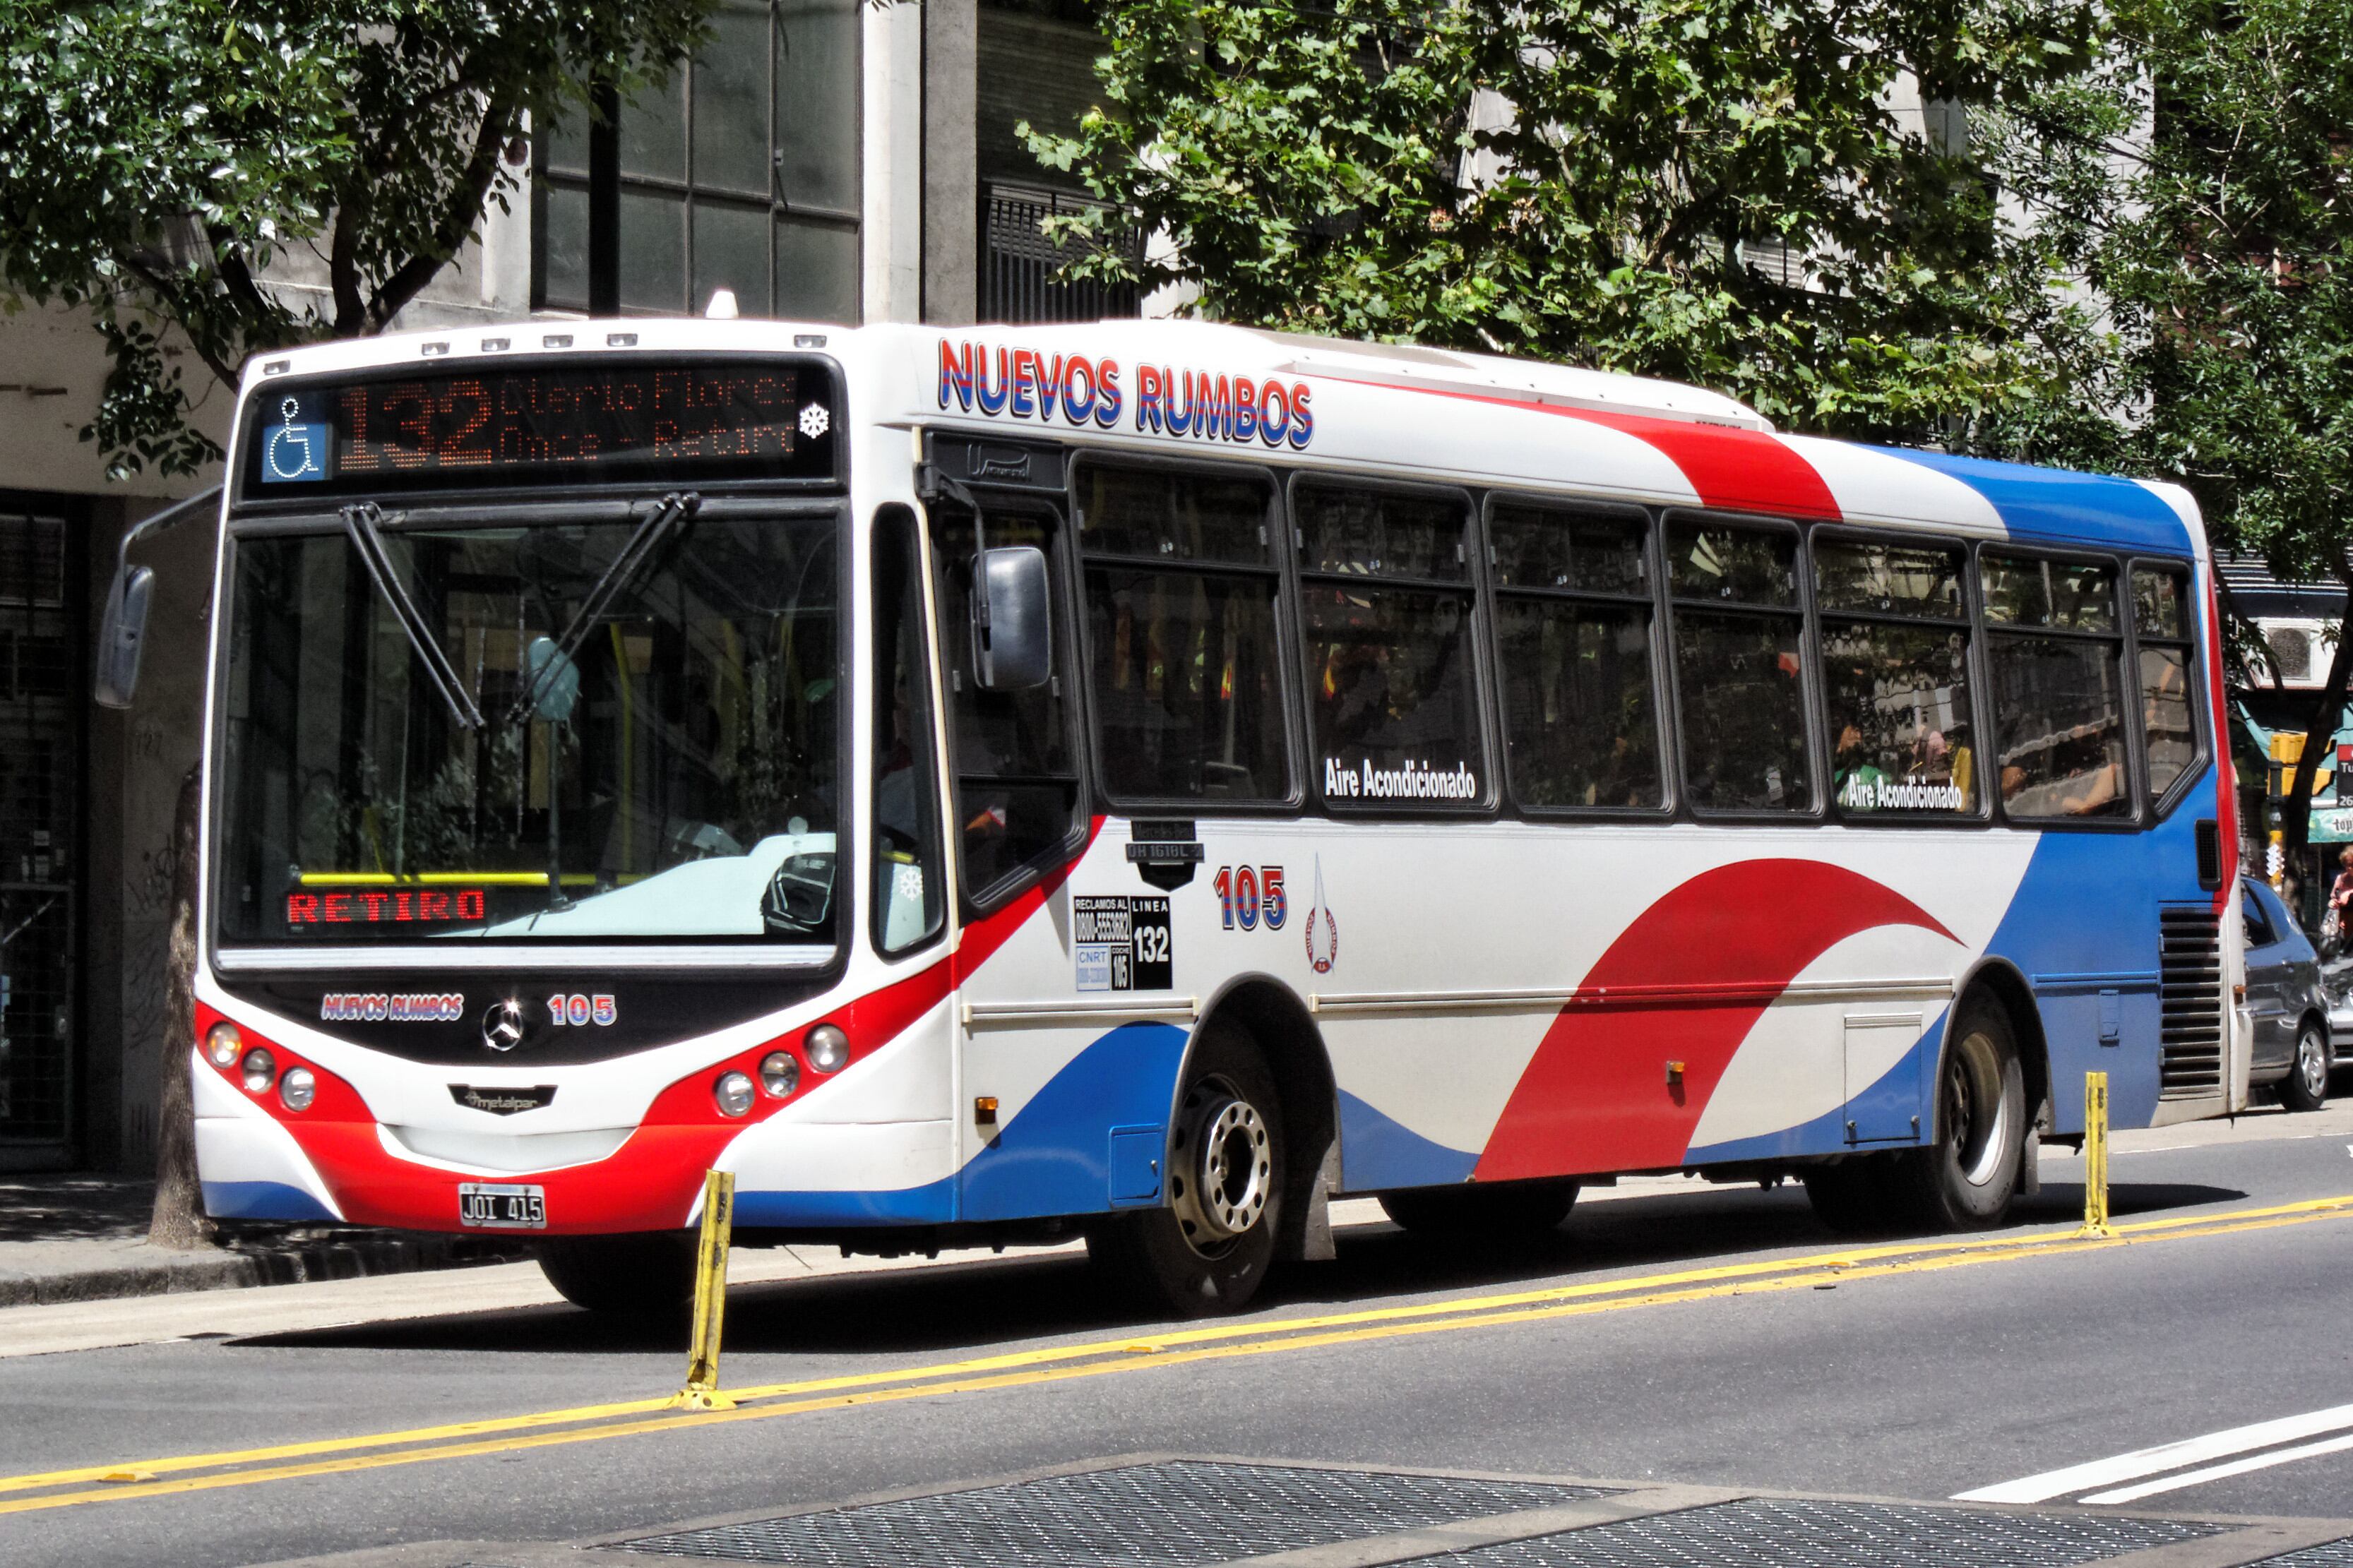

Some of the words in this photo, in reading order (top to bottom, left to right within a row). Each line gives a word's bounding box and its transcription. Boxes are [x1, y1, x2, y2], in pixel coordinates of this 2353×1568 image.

[939, 337, 1123, 428] NUEVOS
[1136, 363, 1315, 449] RUMBOS
[340, 381, 492, 470] 132
[1326, 758, 1359, 797] Aire
[1363, 758, 1475, 798] Acondicionado
[1848, 774, 1874, 807] Aire
[1877, 774, 1962, 809] Acondicionado
[288, 890, 484, 923] RETIRO
[1075, 899, 1116, 909] RECLAMOS
[1117, 899, 1128, 909] AL
[1132, 900, 1169, 912] LINEA
[1213, 865, 1288, 931] 105
[1079, 951, 1107, 963] CNRT
[1133, 926, 1169, 963] 132
[321, 993, 389, 1021] NUEVOS
[389, 993, 464, 1021] RUMBOS
[547, 994, 617, 1027] 105
[475, 1096, 537, 1111] metalpar
[463, 1196, 497, 1220] JOI
[507, 1197, 542, 1221] 415
